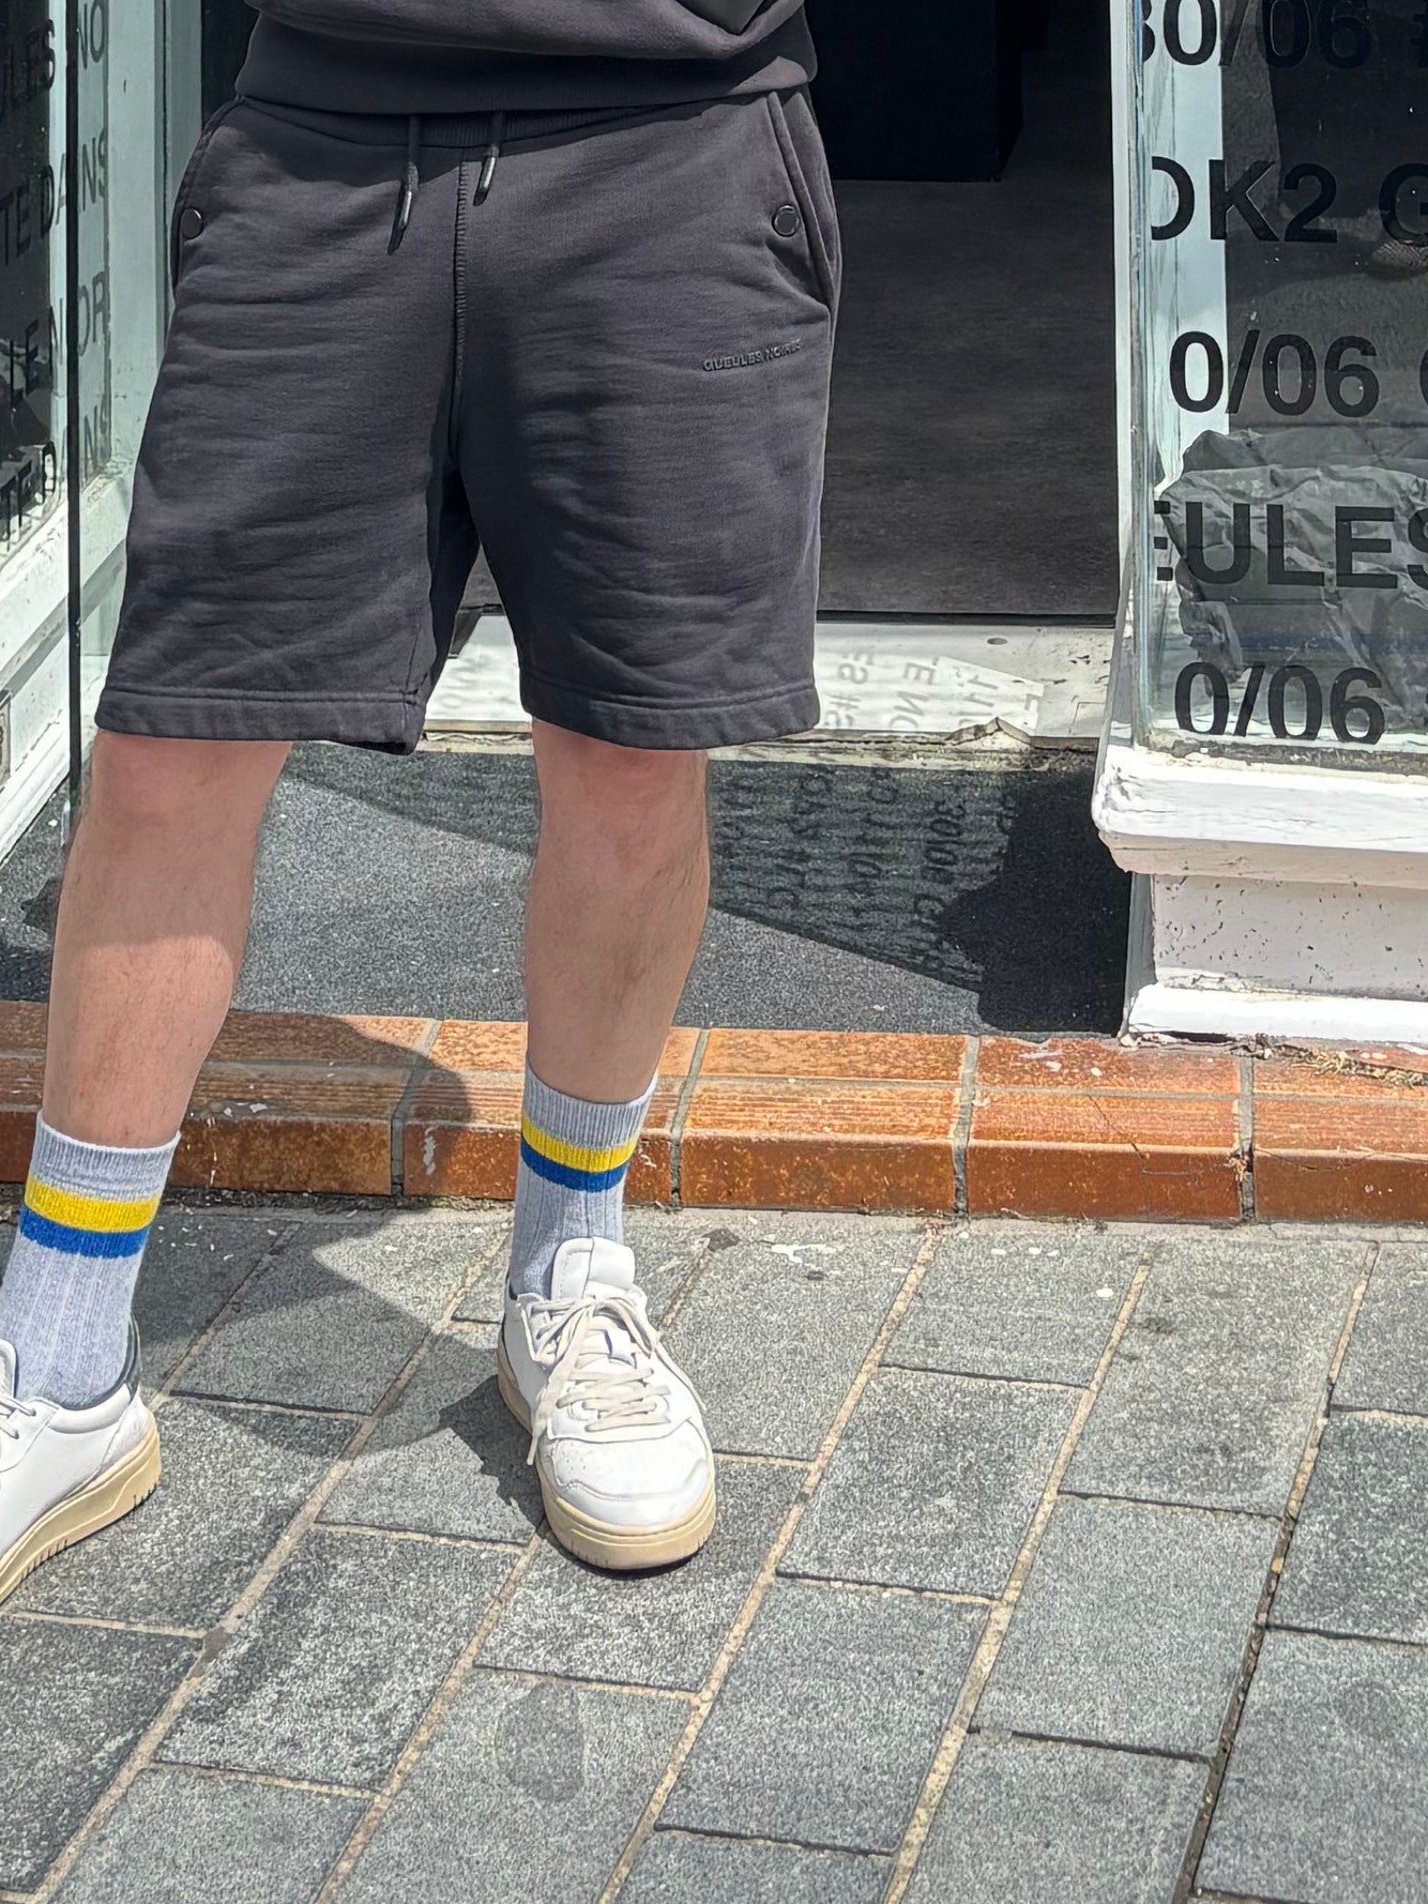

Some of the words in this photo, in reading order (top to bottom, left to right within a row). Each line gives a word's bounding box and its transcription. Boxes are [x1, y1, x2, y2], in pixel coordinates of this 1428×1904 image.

[703, 351, 763, 372] GUEULES
[1169, 329, 1380, 418] 0/06
[1175, 660, 1384, 746] 0/06
